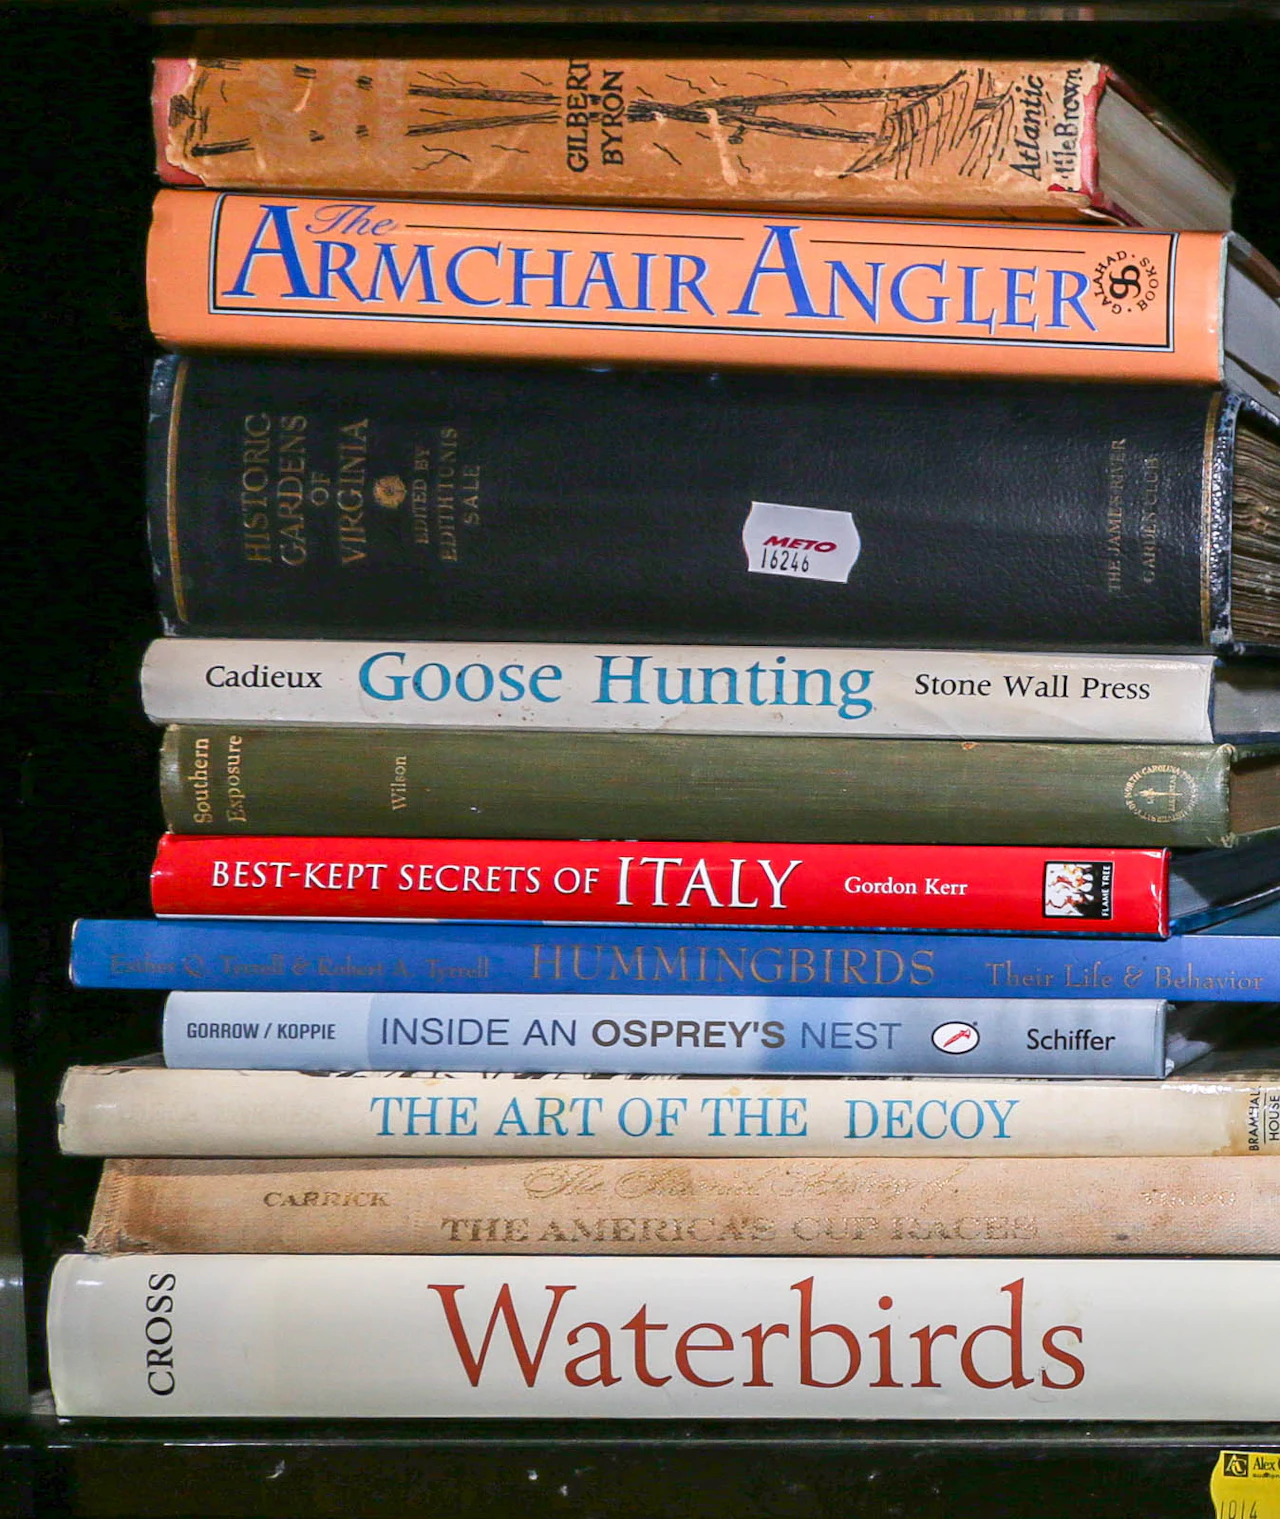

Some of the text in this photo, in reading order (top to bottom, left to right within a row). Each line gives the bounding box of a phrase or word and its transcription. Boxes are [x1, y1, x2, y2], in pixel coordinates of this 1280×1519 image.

[565, 57, 590, 174] GILBERT
[602, 68, 625, 167] BYRON
[1009, 74, 1044, 181] Atlantic
[305, 204, 396, 237] The
[221, 204, 1099, 335] ARMCHAIR ANGLER
[1093, 250, 1160, 315] GALAHAD BOOKS
[241, 412, 271, 563] HISTORIC
[277, 414, 308, 567] GARDENS
[310, 471, 331, 507] OF
[337, 417, 370, 567] VIRGINIA
[761, 547, 809, 573] 16246
[763, 535, 837, 553] METO
[205, 651, 1151, 720] Cadieux Goose Hunting Stone Wall Press
[193, 737, 211, 824] Southern
[226, 735, 248, 823] Exposure
[391, 755, 407, 811] Wilson
[210, 856, 803, 910] BEST-KEPT SECRETS OF ITALY
[844, 875, 969, 897] Gordon Kerr
[1101, 865, 1111, 917] FLAME TREE
[530, 943, 936, 986] HUMMINGBIRDS
[986, 961, 1265, 991] Their Life & Behavior
[187, 1022, 336, 1041] GORROW KOPPIE
[381, 1017, 903, 1050] INSIDE AN OSPREY'S NEST
[1026, 1028, 1117, 1053] Schiffer
[370, 1096, 479, 1137] THE
[493, 1096, 604, 1138] ART
[617, 1097, 688, 1138] OF
[700, 1097, 808, 1138] THE
[844, 1099, 1021, 1140] DECOY
[1268, 1095, 1280, 1141] HOUSE
[263, 1191, 391, 1209] CARRICK
[441, 1215, 878, 1243] THE CUP
[146, 1272, 177, 1396] CROSS
[426, 1276, 1087, 1389] Waterbirds
[1253, 1456, 1277, 1472] Alex
